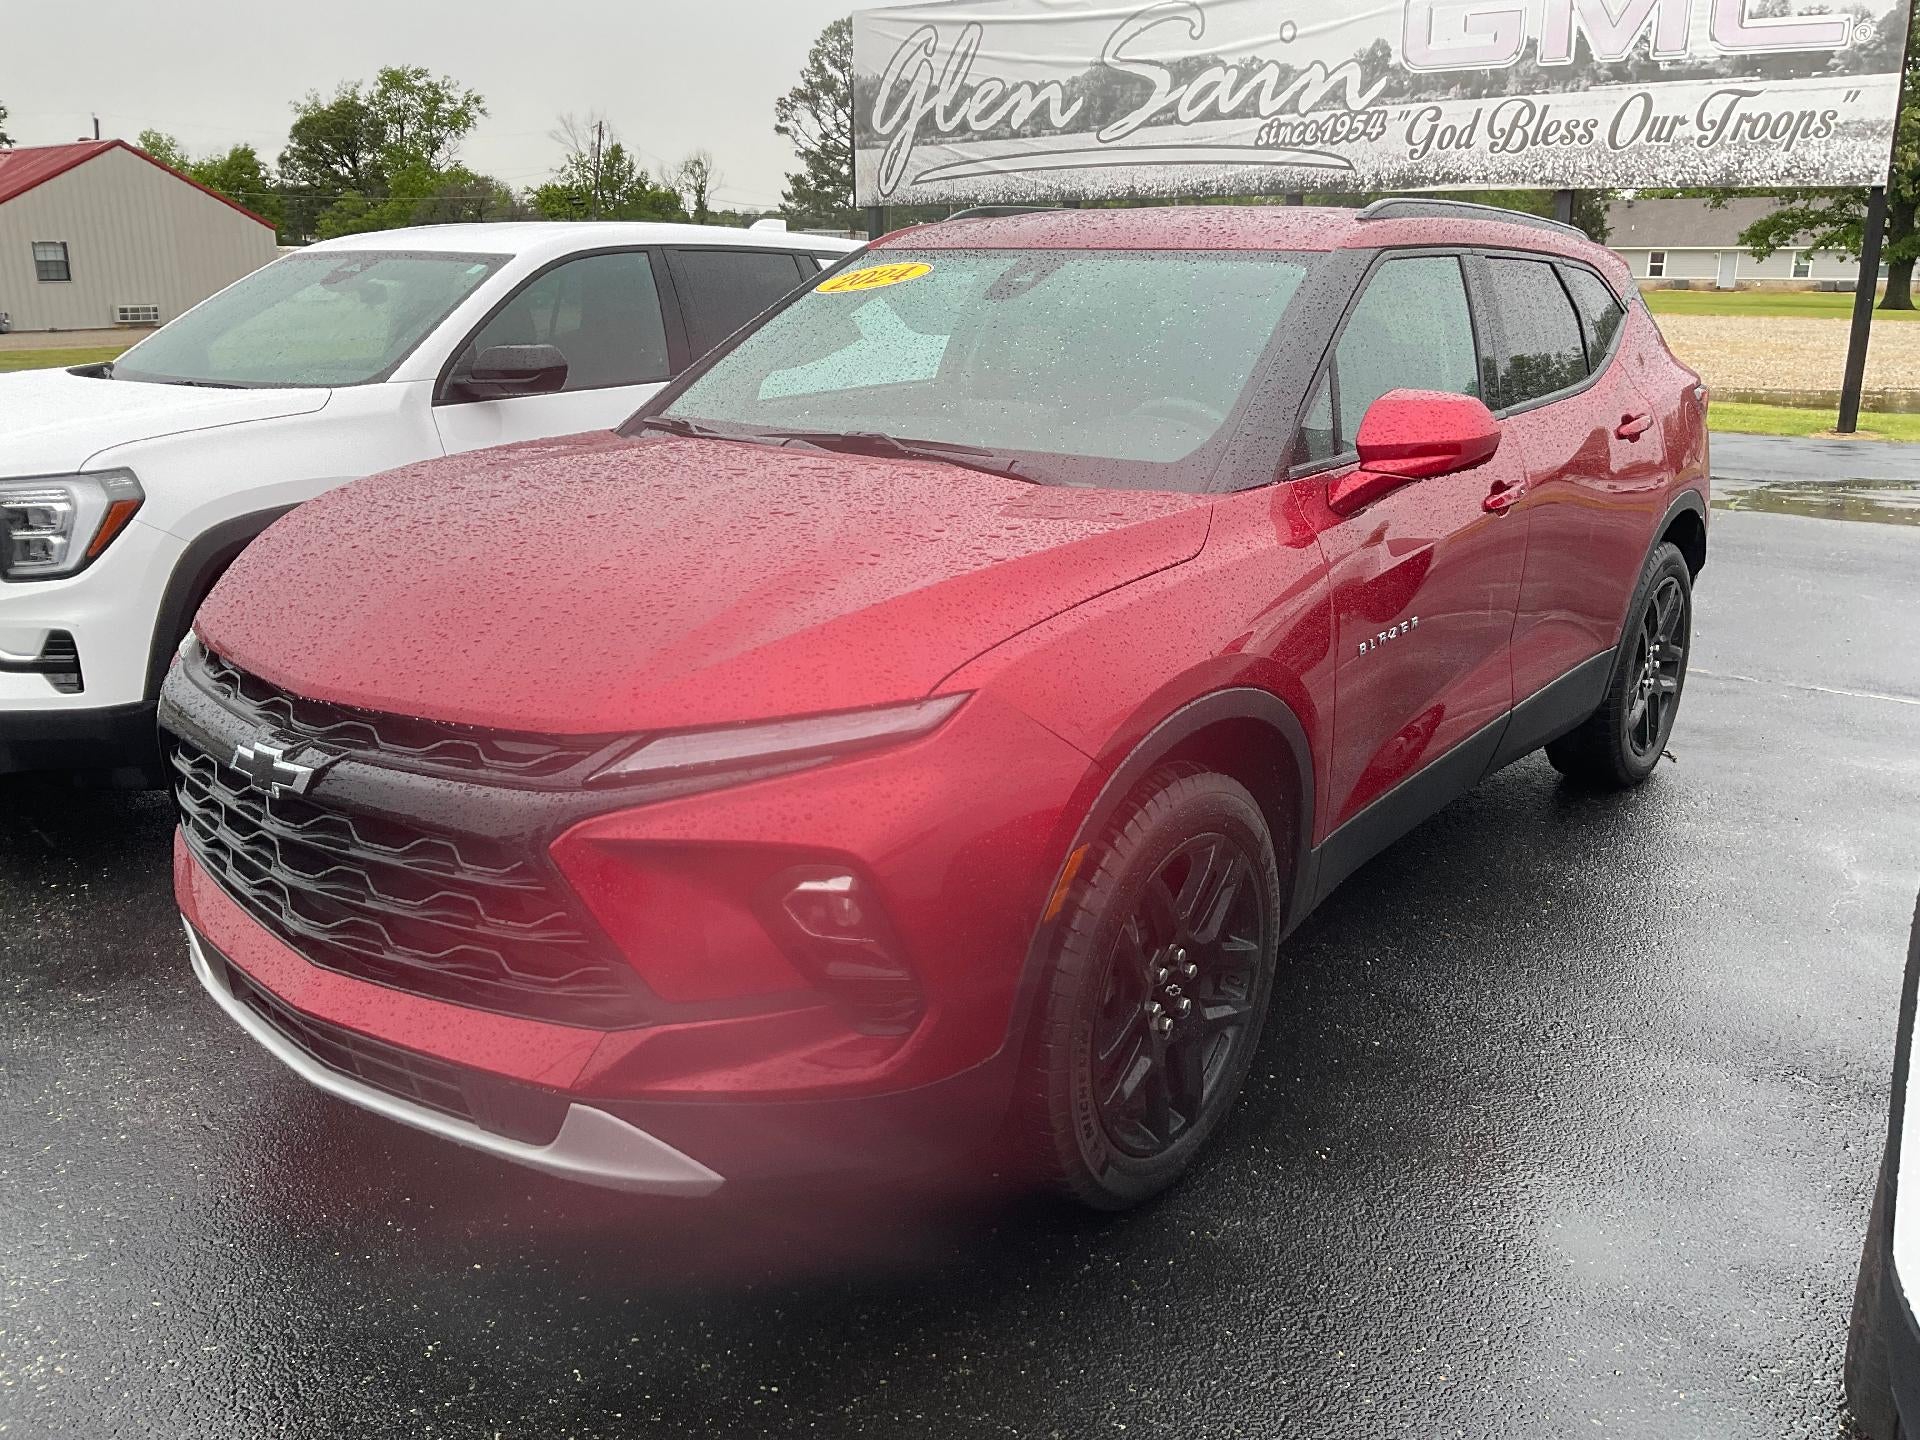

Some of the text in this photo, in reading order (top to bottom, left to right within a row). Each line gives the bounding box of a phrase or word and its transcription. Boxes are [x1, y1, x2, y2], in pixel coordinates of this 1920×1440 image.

[872, 0, 1388, 197] Glen Sain
[1487, 97, 1599, 155] Bless
[1606, 91, 1689, 152] Our
[828, 265, 920, 290] 2024
[1359, 616, 1418, 655] BLAZER
